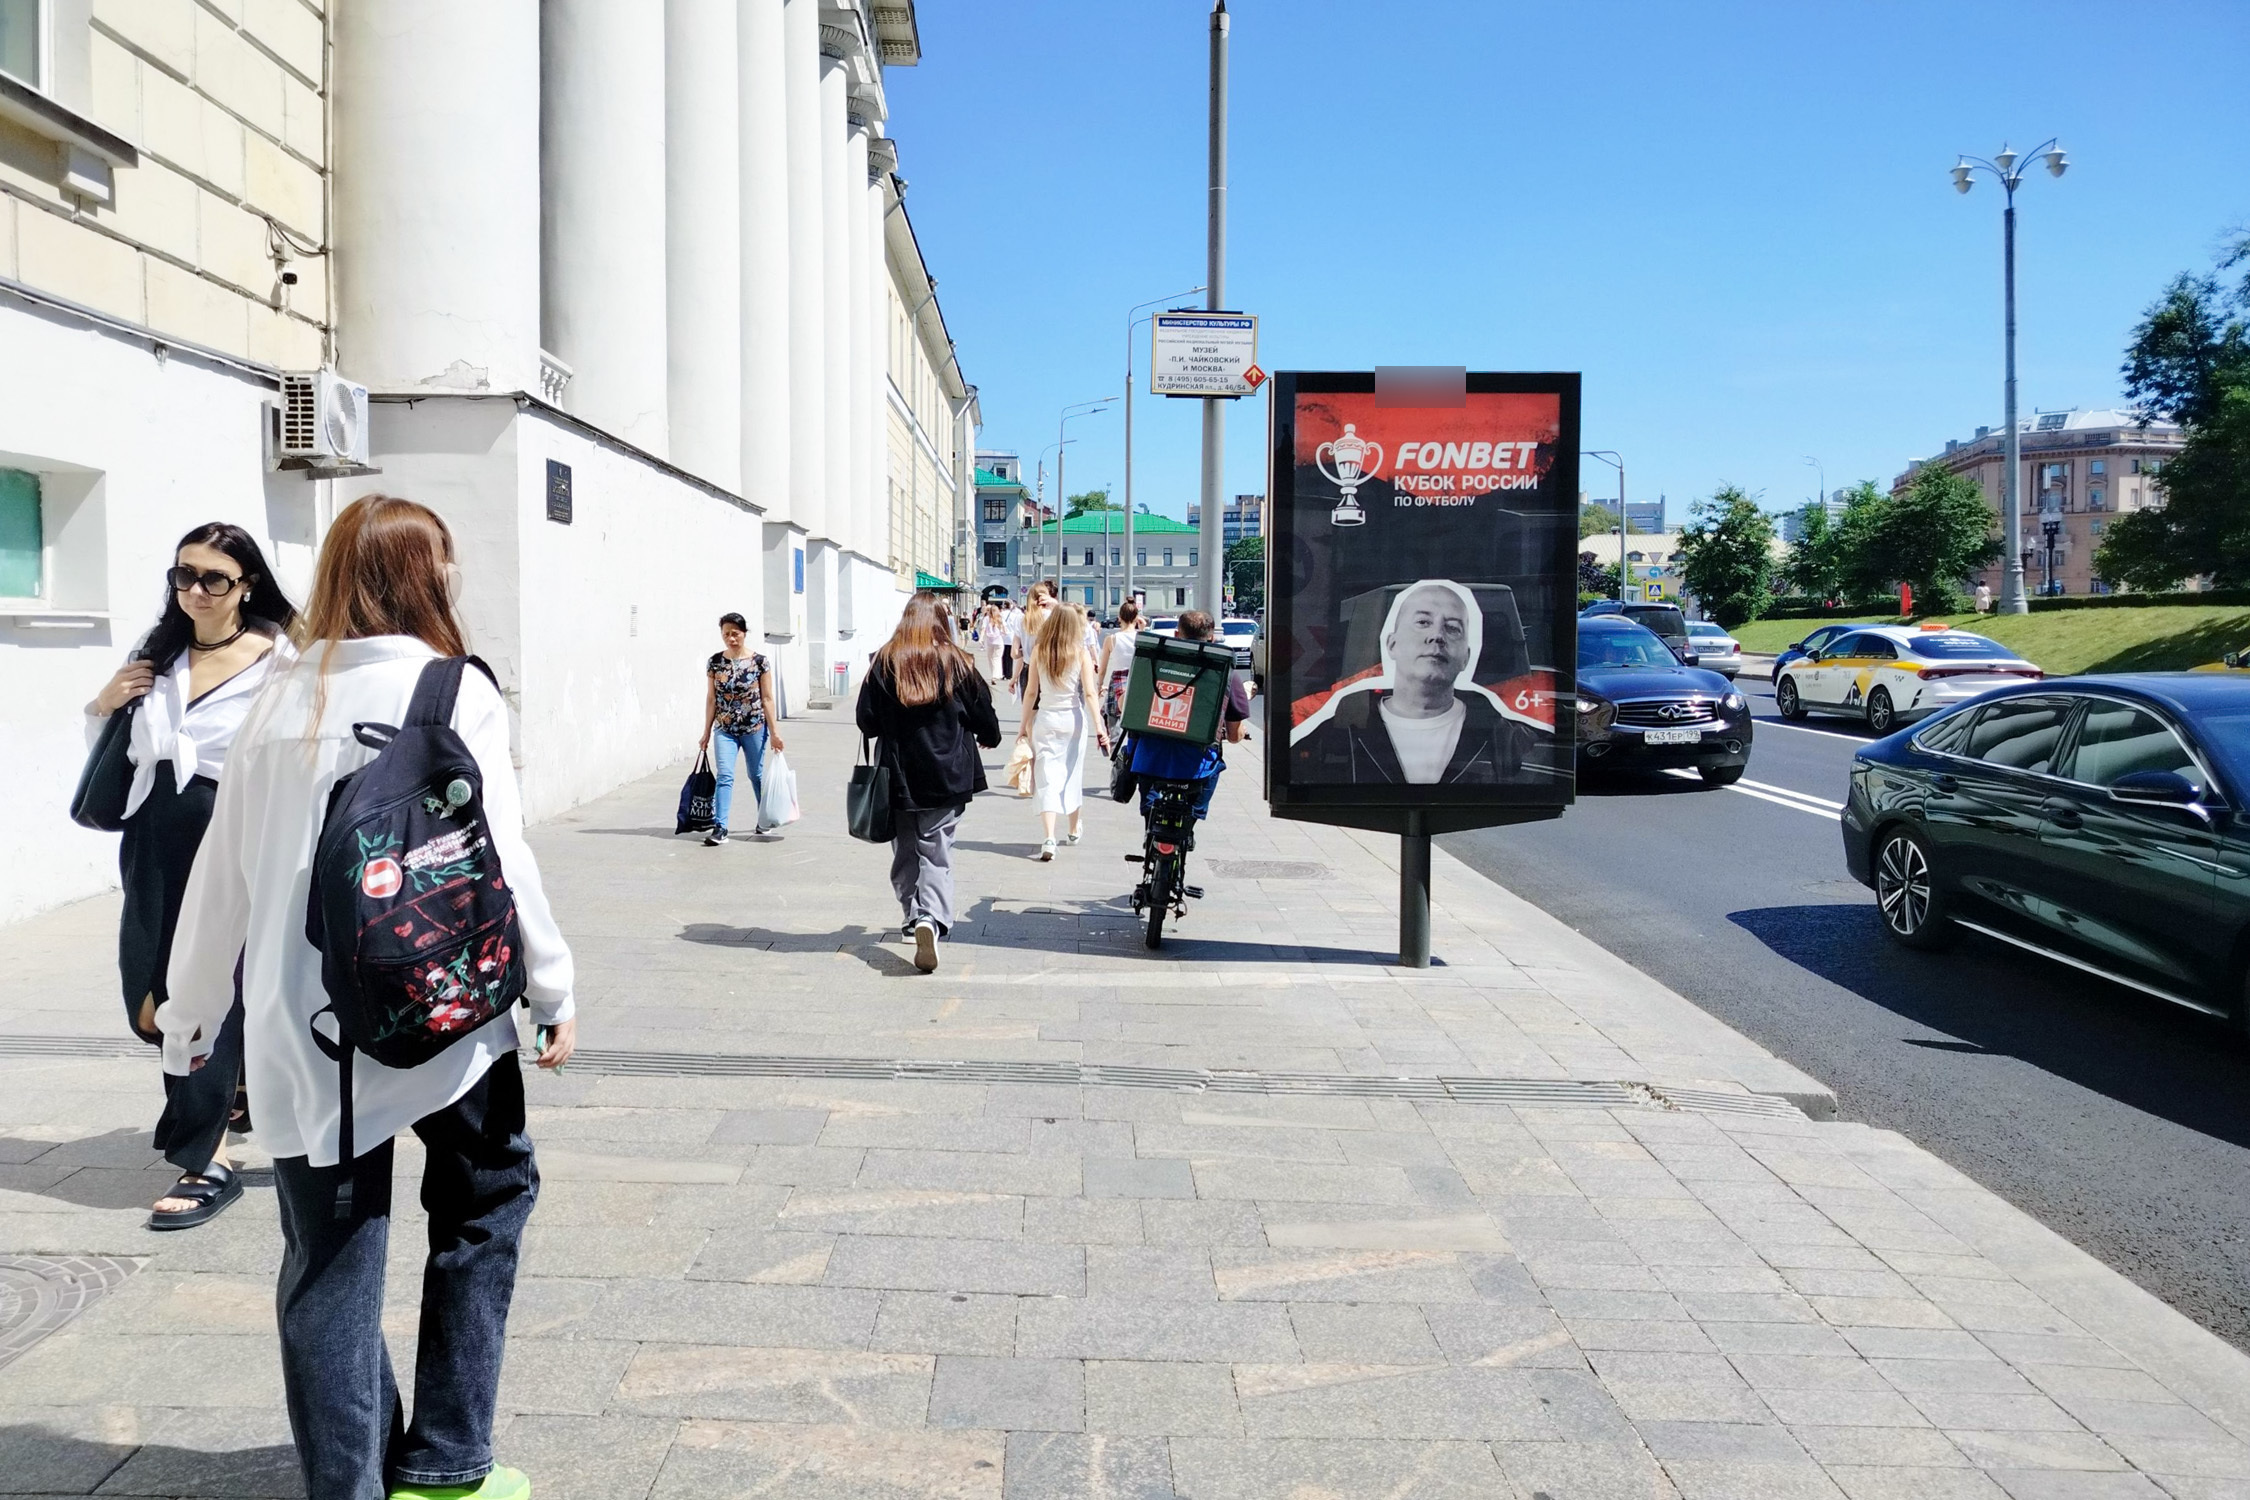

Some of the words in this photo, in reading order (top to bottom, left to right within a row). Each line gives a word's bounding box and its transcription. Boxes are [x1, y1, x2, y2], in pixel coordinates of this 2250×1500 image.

[1192, 346, 1218, 354] МУЗЕЙ
[1188, 355, 1240, 364] ЧАЙКОВСКИЙ
[1224, 384, 1246, 392] 46/54
[1394, 441, 1539, 470] FONBET
[1394, 475, 1456, 491] КУБОК
[1461, 474, 1538, 490] РОССИИ
[1394, 496, 1412, 507] ПО
[1414, 495, 1476, 507] ФУТБОЛУ
[1158, 683, 1191, 695] КОФЕ
[1515, 690, 1543, 710] 6+
[1151, 717, 1185, 729] МАНИЯ
